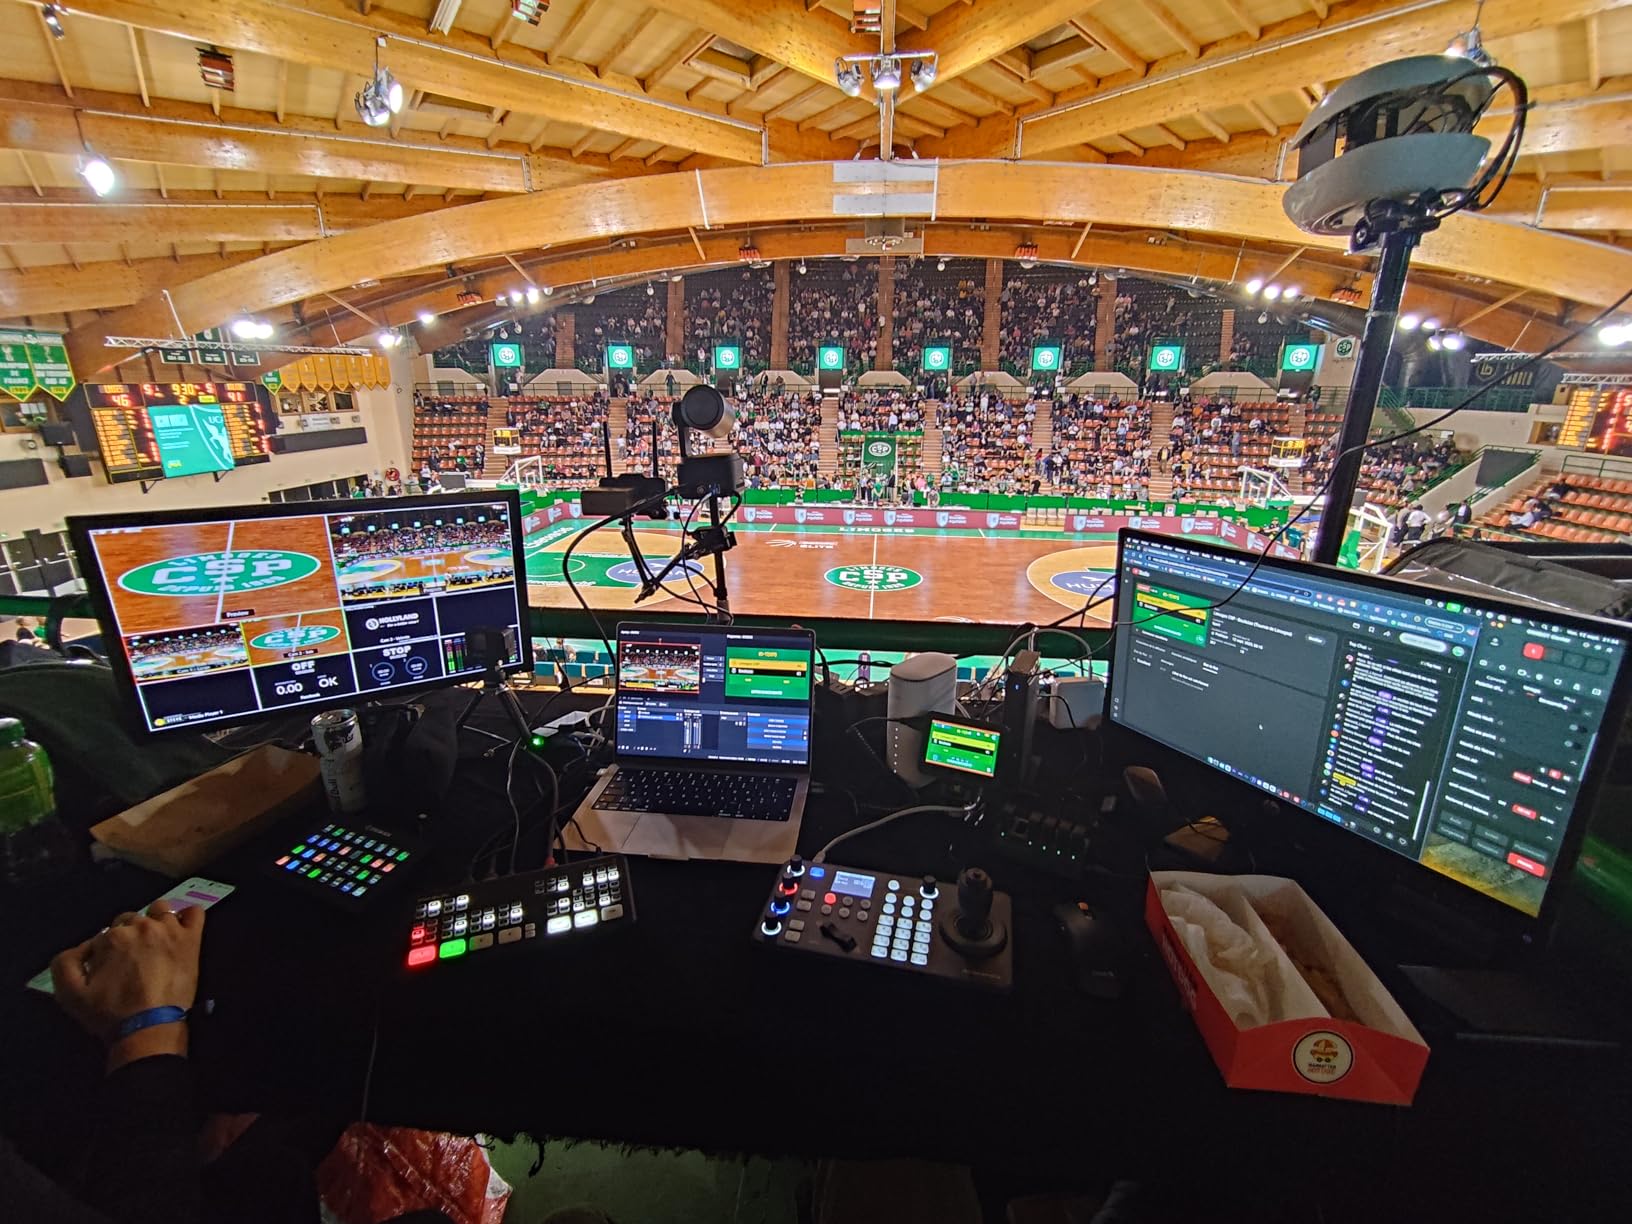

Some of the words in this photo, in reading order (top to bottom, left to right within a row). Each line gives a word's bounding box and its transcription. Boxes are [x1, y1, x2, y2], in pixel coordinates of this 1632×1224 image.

[1338, 342, 1351, 352] CSP
[111, 393, 130, 408] 46
[871, 444, 889, 453] CSP
[152, 558, 292, 585] CSP
[839, 569, 908, 582] CSP
[226, 610, 250, 618] Preview
[378, 612, 419, 624] HOLLYLAND
[264, 628, 328, 645] CSP
[383, 645, 412, 657] STOP
[291, 661, 315, 671] OFF
[318, 676, 338, 688] OK
[276, 683, 304, 696] 0.00
